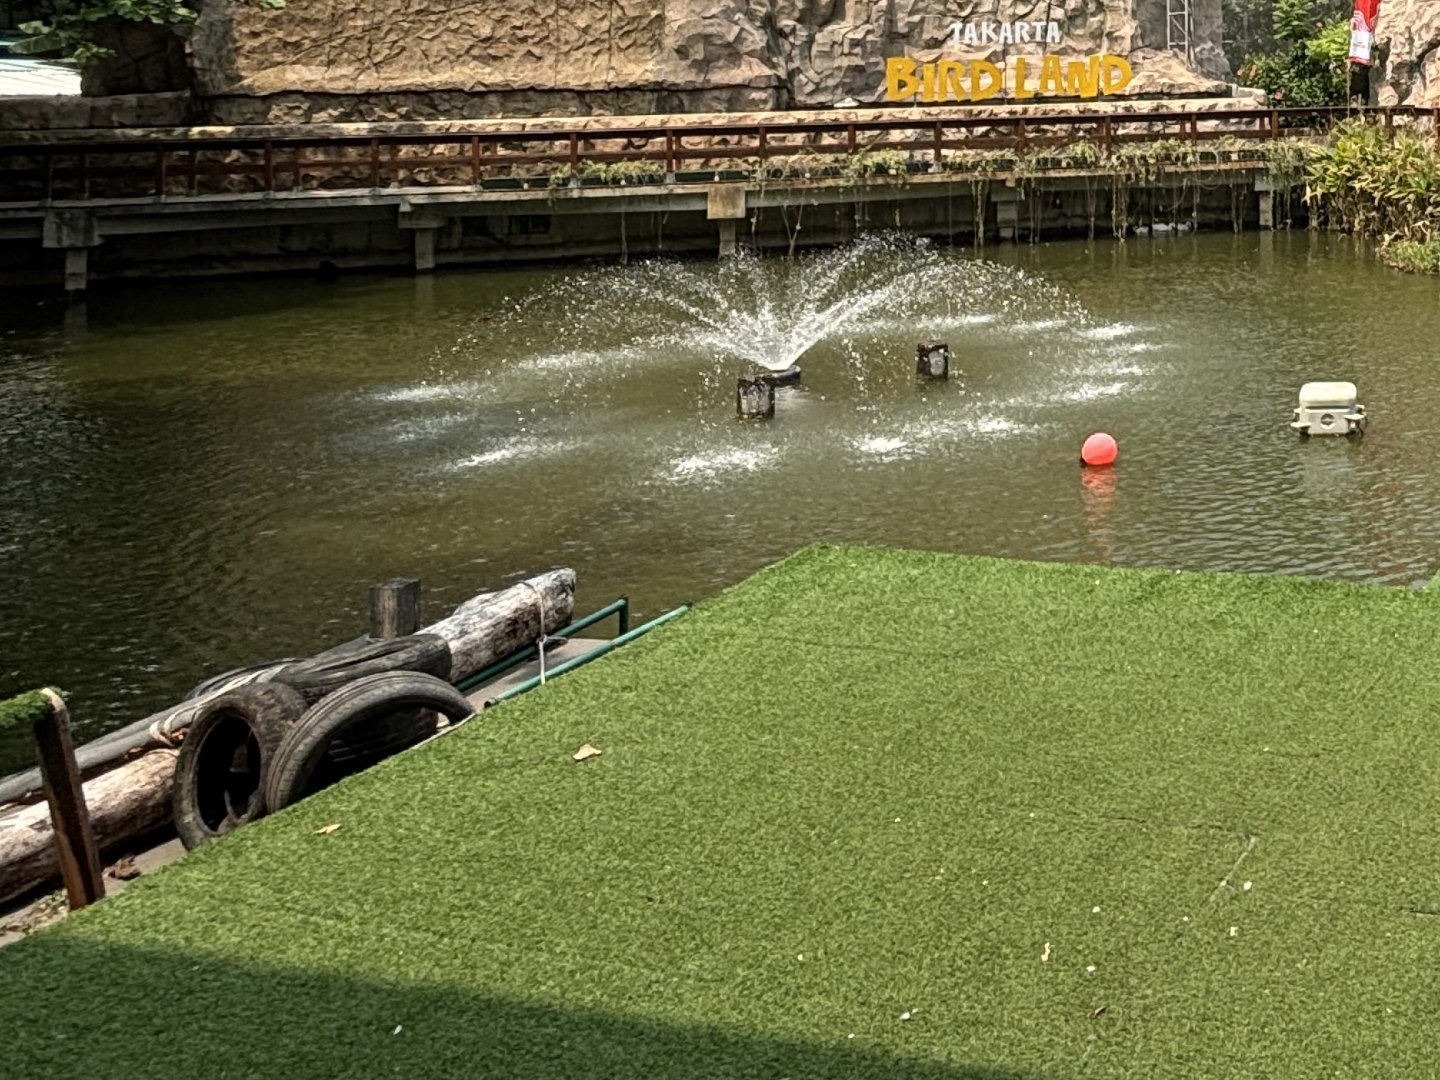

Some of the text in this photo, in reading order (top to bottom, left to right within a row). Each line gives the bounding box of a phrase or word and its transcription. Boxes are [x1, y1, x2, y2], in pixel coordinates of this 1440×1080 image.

[949, 21, 1062, 45] JAKARTA
[886, 53, 1135, 103] BIRD LAND
